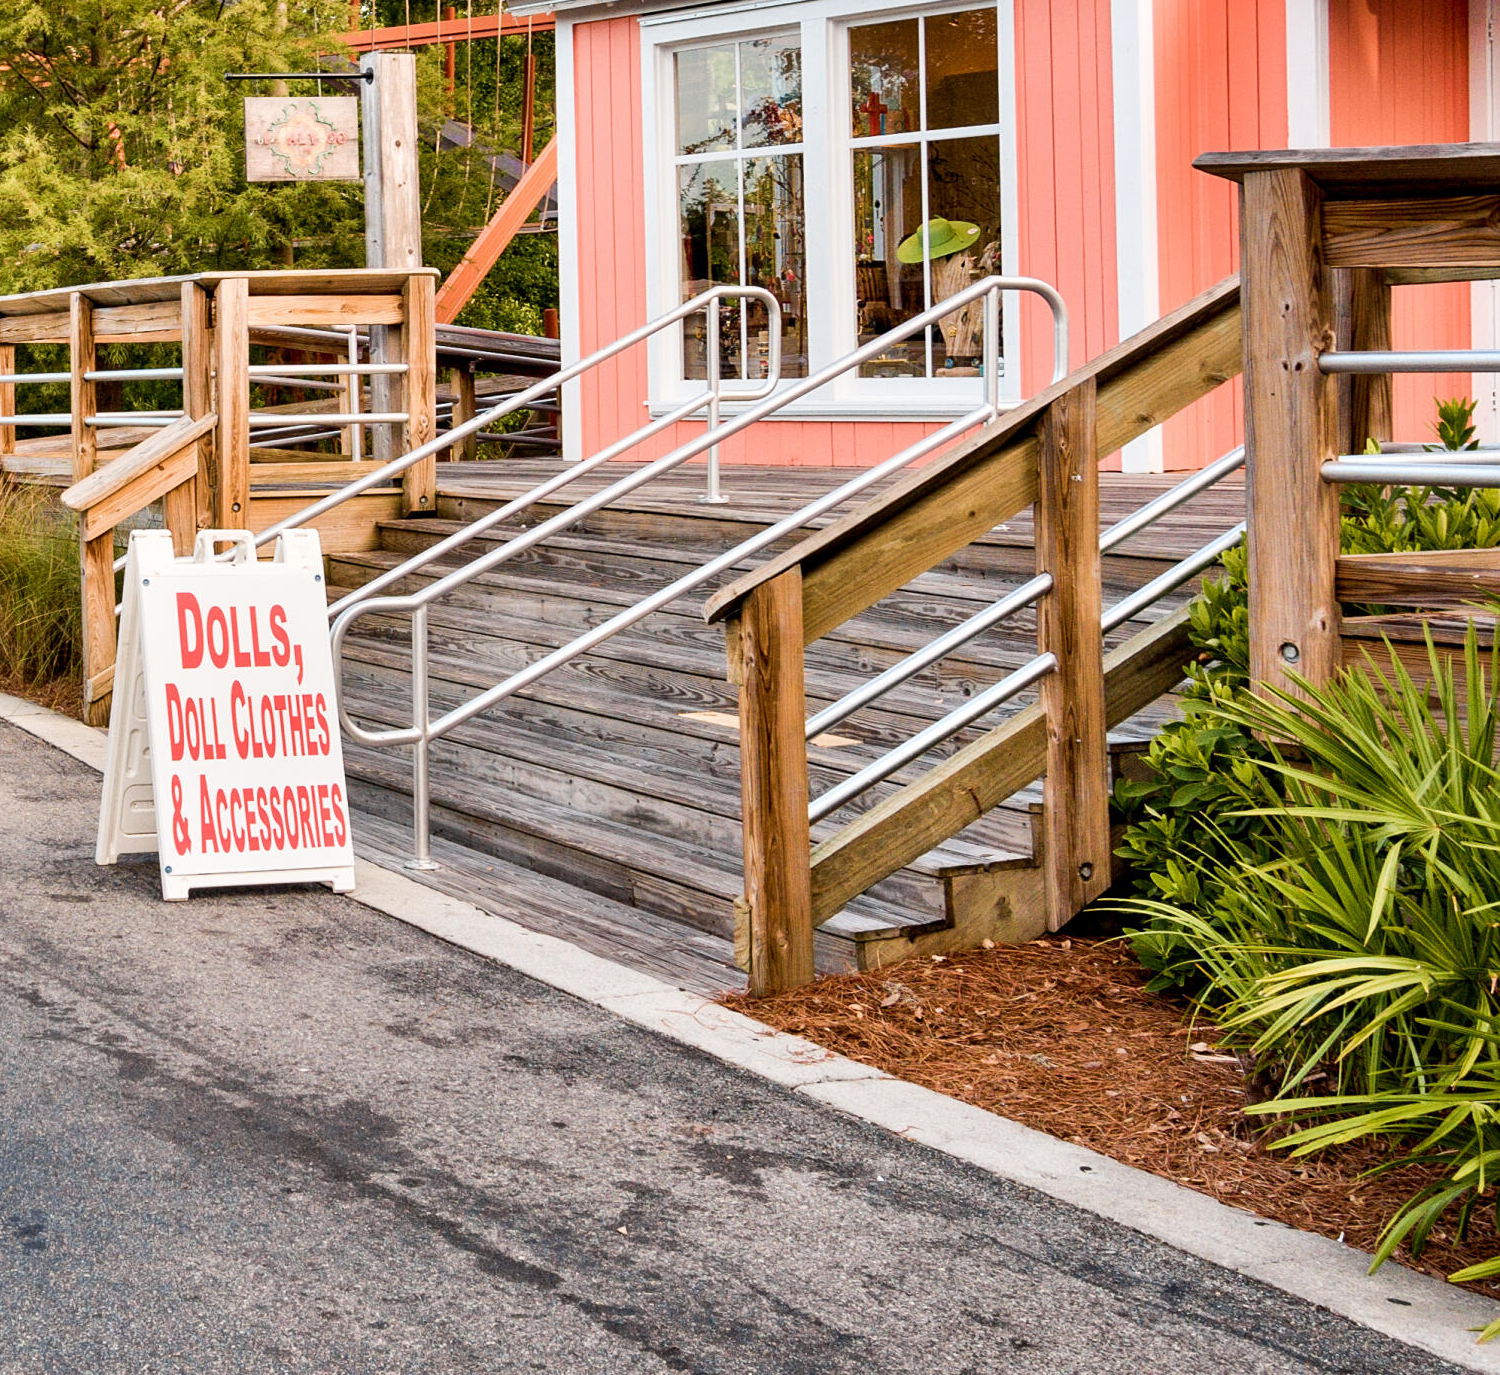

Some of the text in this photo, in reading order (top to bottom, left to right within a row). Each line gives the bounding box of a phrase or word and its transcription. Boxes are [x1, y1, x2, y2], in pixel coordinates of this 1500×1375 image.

[176, 592, 303, 685] DOLLS,
[165, 680, 331, 761] DOLL CLOTHES
[171, 773, 347, 856] & ACCESSORIES
